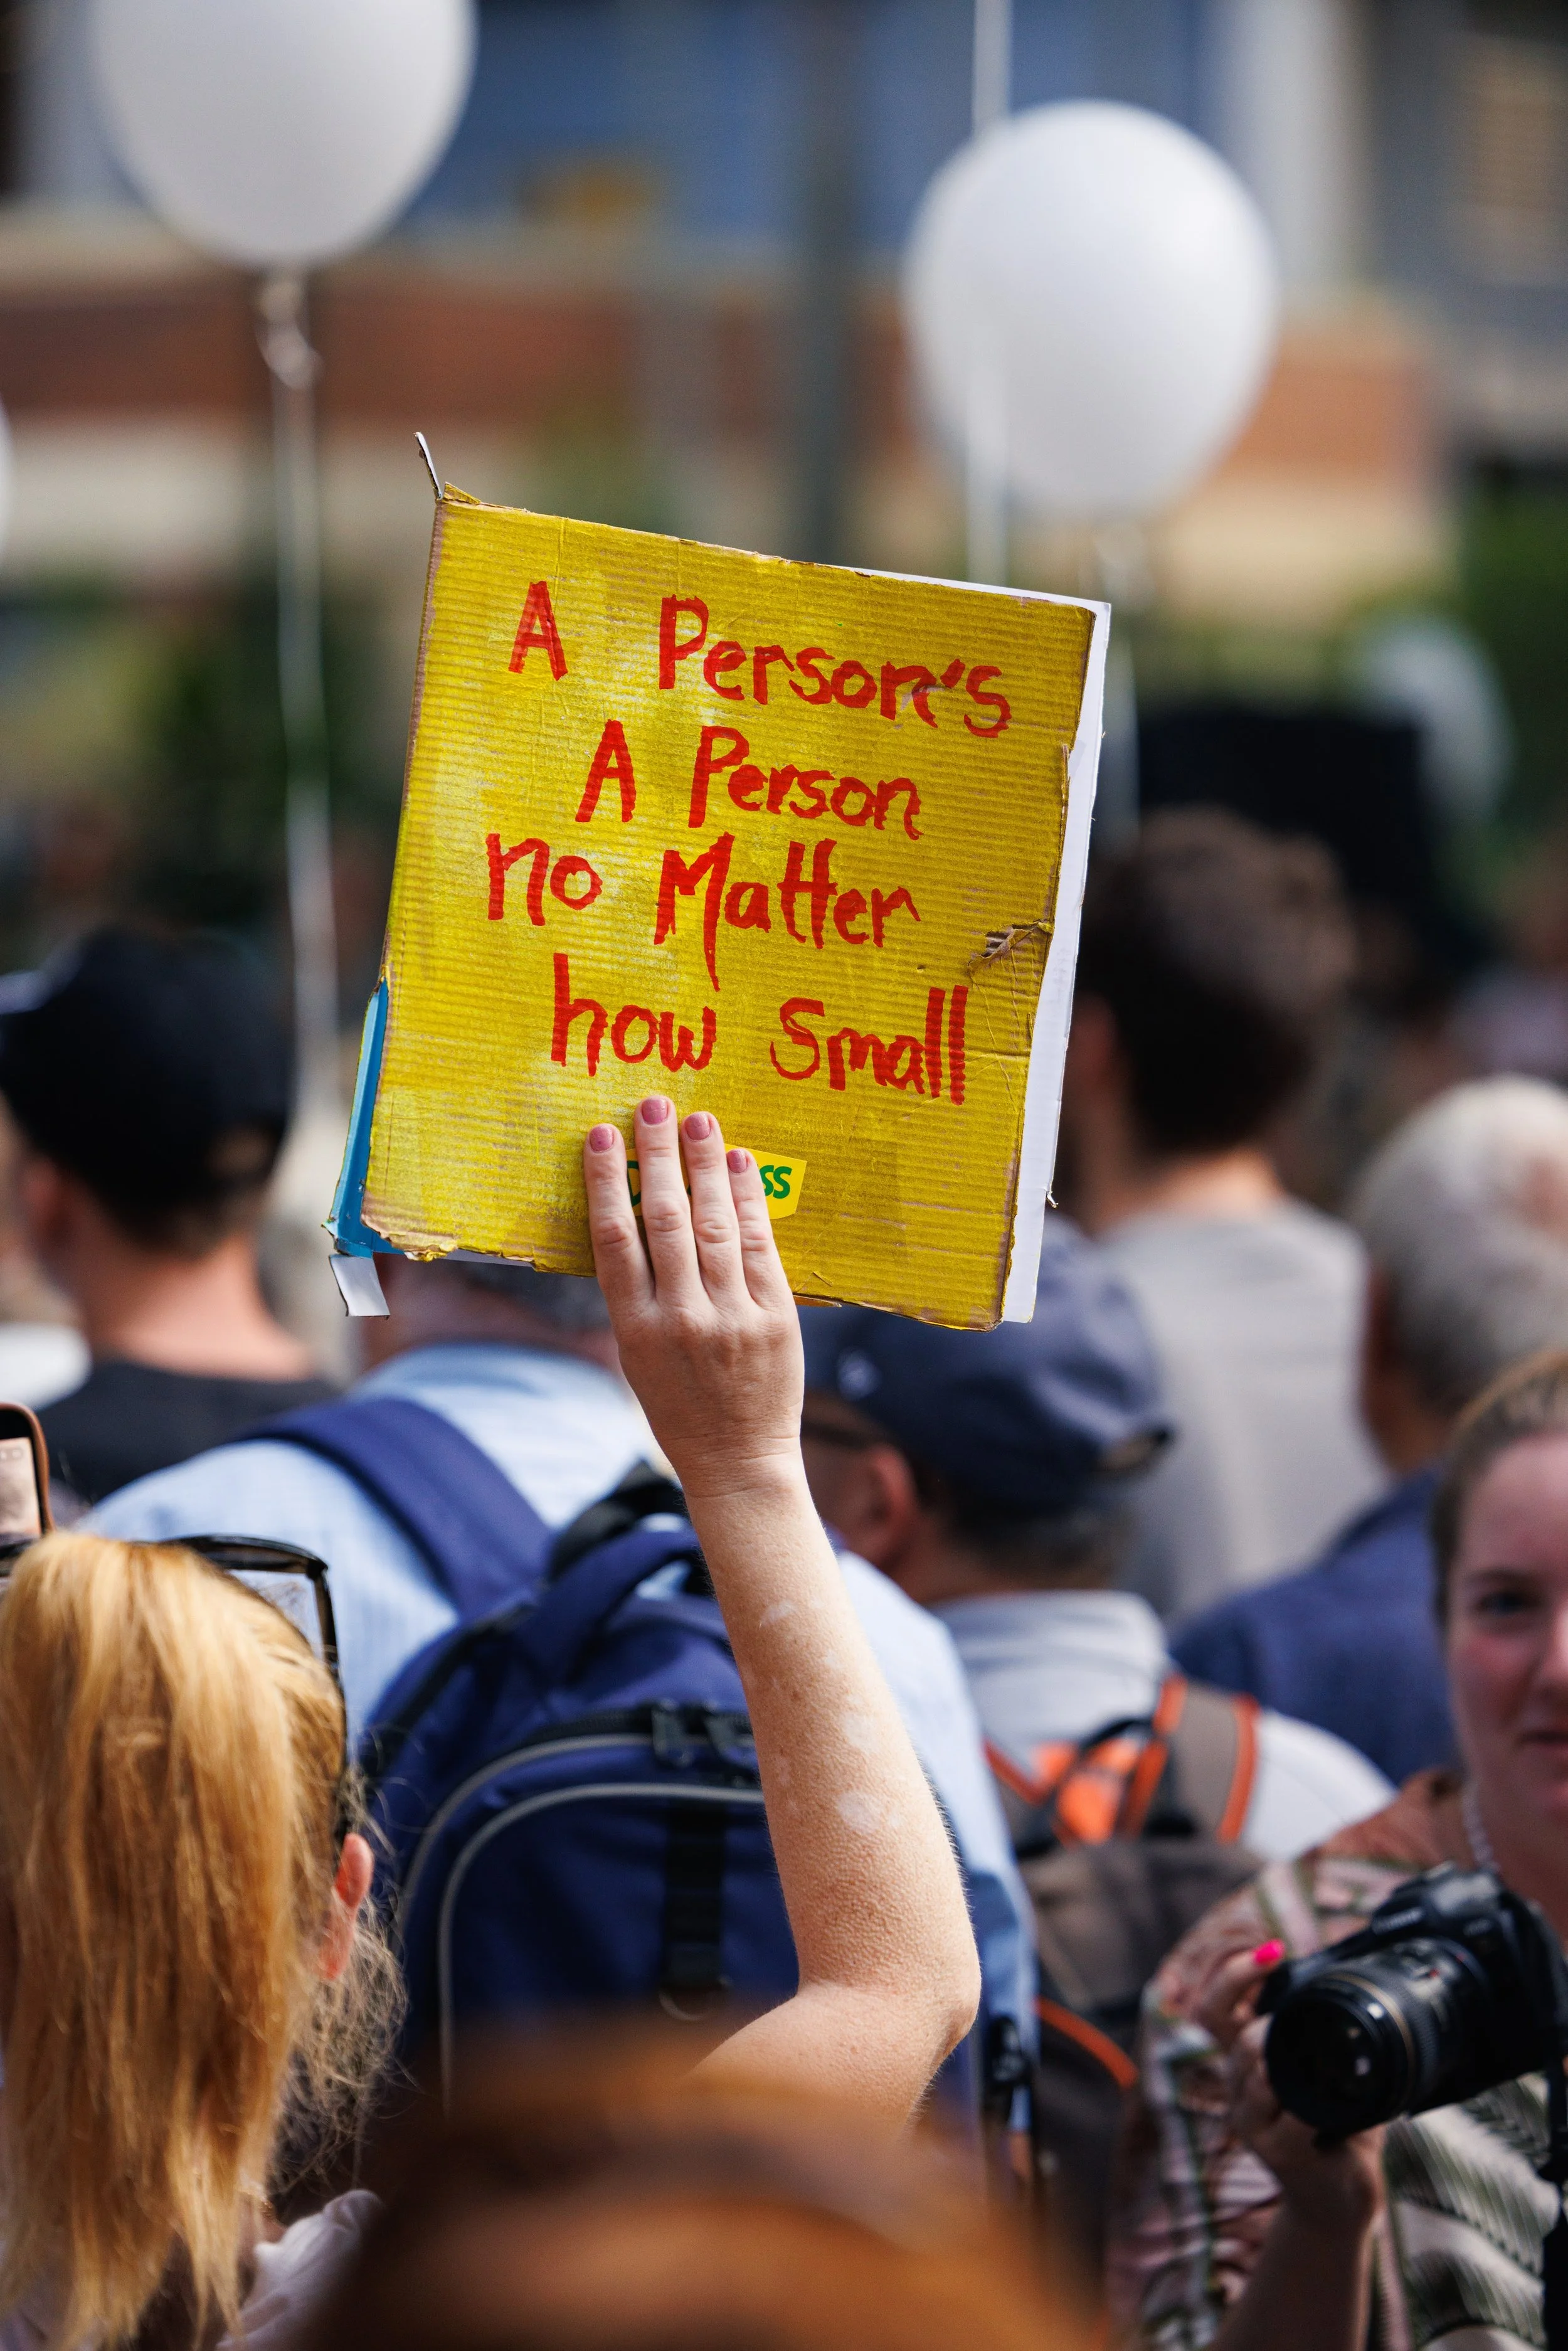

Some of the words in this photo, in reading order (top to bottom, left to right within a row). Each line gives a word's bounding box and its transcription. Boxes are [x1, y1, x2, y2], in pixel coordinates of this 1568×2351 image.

[509, 581, 568, 681] A
[659, 594, 1012, 738] Person's
[575, 720, 636, 822] A
[688, 726, 923, 841] Person
[486, 833, 603, 926] no
[654, 832, 920, 991] Matter
[551, 953, 716, 1076] how
[770, 985, 968, 1105] Small
